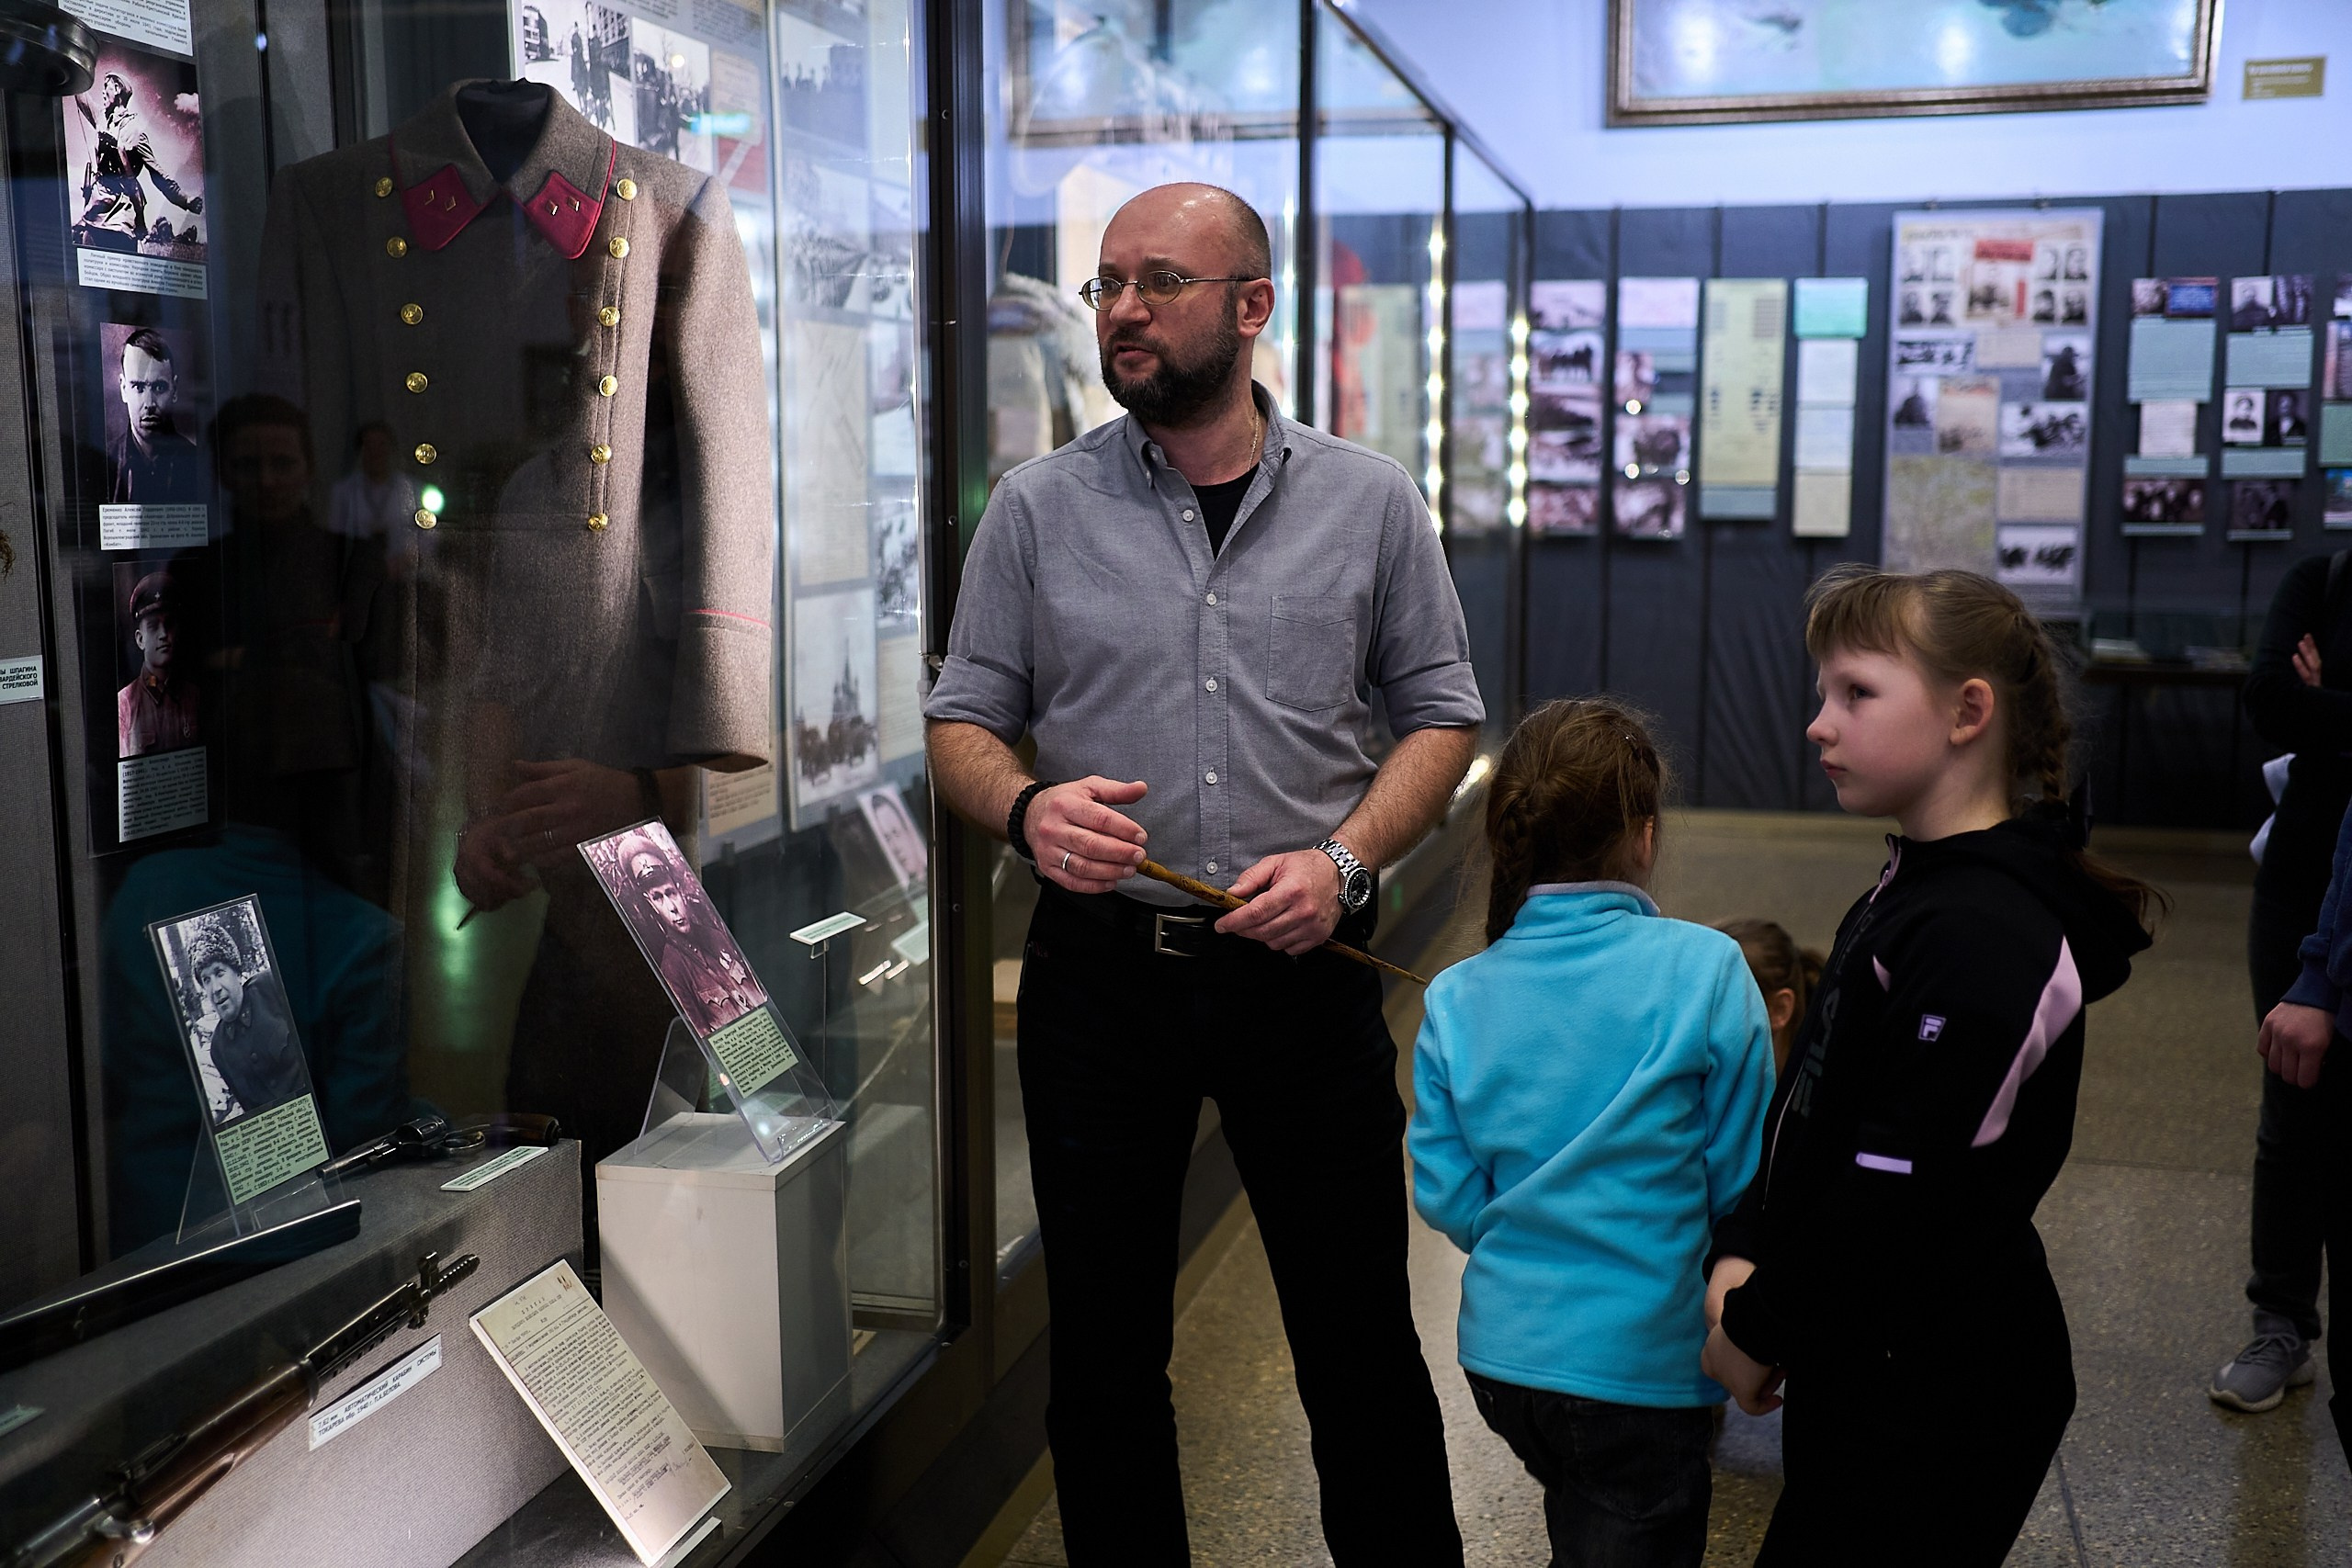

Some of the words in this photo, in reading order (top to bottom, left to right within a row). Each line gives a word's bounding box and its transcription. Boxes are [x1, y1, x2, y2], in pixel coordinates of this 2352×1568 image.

[2, 679, 38, 689] СТРЕЛКОВОЙ
[240, 1119, 260, 1131] Василий
[261, 1107, 286, 1122] Андреевич
[277, 1111, 294, 1122] Тульской
[344, 1381, 389, 1414] АВТОМАТИЧЕСКИЙ
[392, 1366, 413, 1382] КАРАБИН
[417, 1348, 436, 1367] СИСТЕМЫ
[319, 1418, 345, 1436] ТОКАРЕВА
[357, 1403, 369, 1415] 1940
